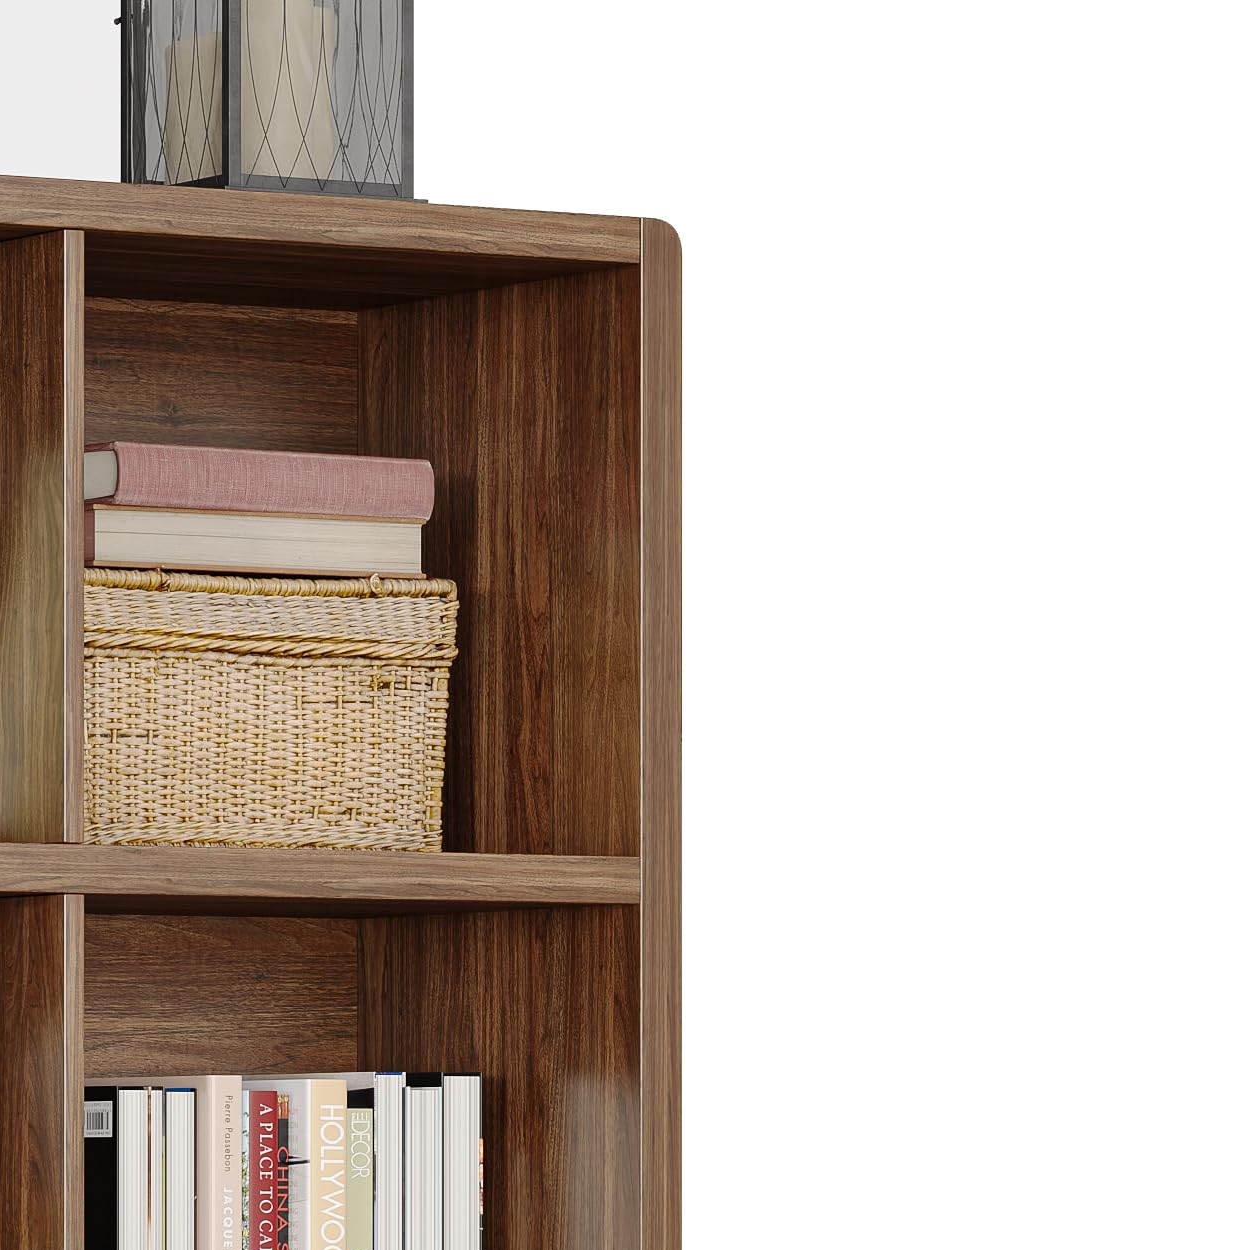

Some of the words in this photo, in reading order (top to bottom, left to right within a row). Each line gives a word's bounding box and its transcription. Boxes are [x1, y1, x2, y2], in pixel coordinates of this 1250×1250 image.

[224, 1095, 234, 1122] Pierre
[259, 1103, 273, 1116] A
[224, 1128, 234, 1172] Passebon
[259, 1122, 273, 1180] PLACE
[351, 1120, 371, 1179] DECOR
[259, 1186, 273, 1214] TO
[277, 1146, 289, 1232] CHINA
